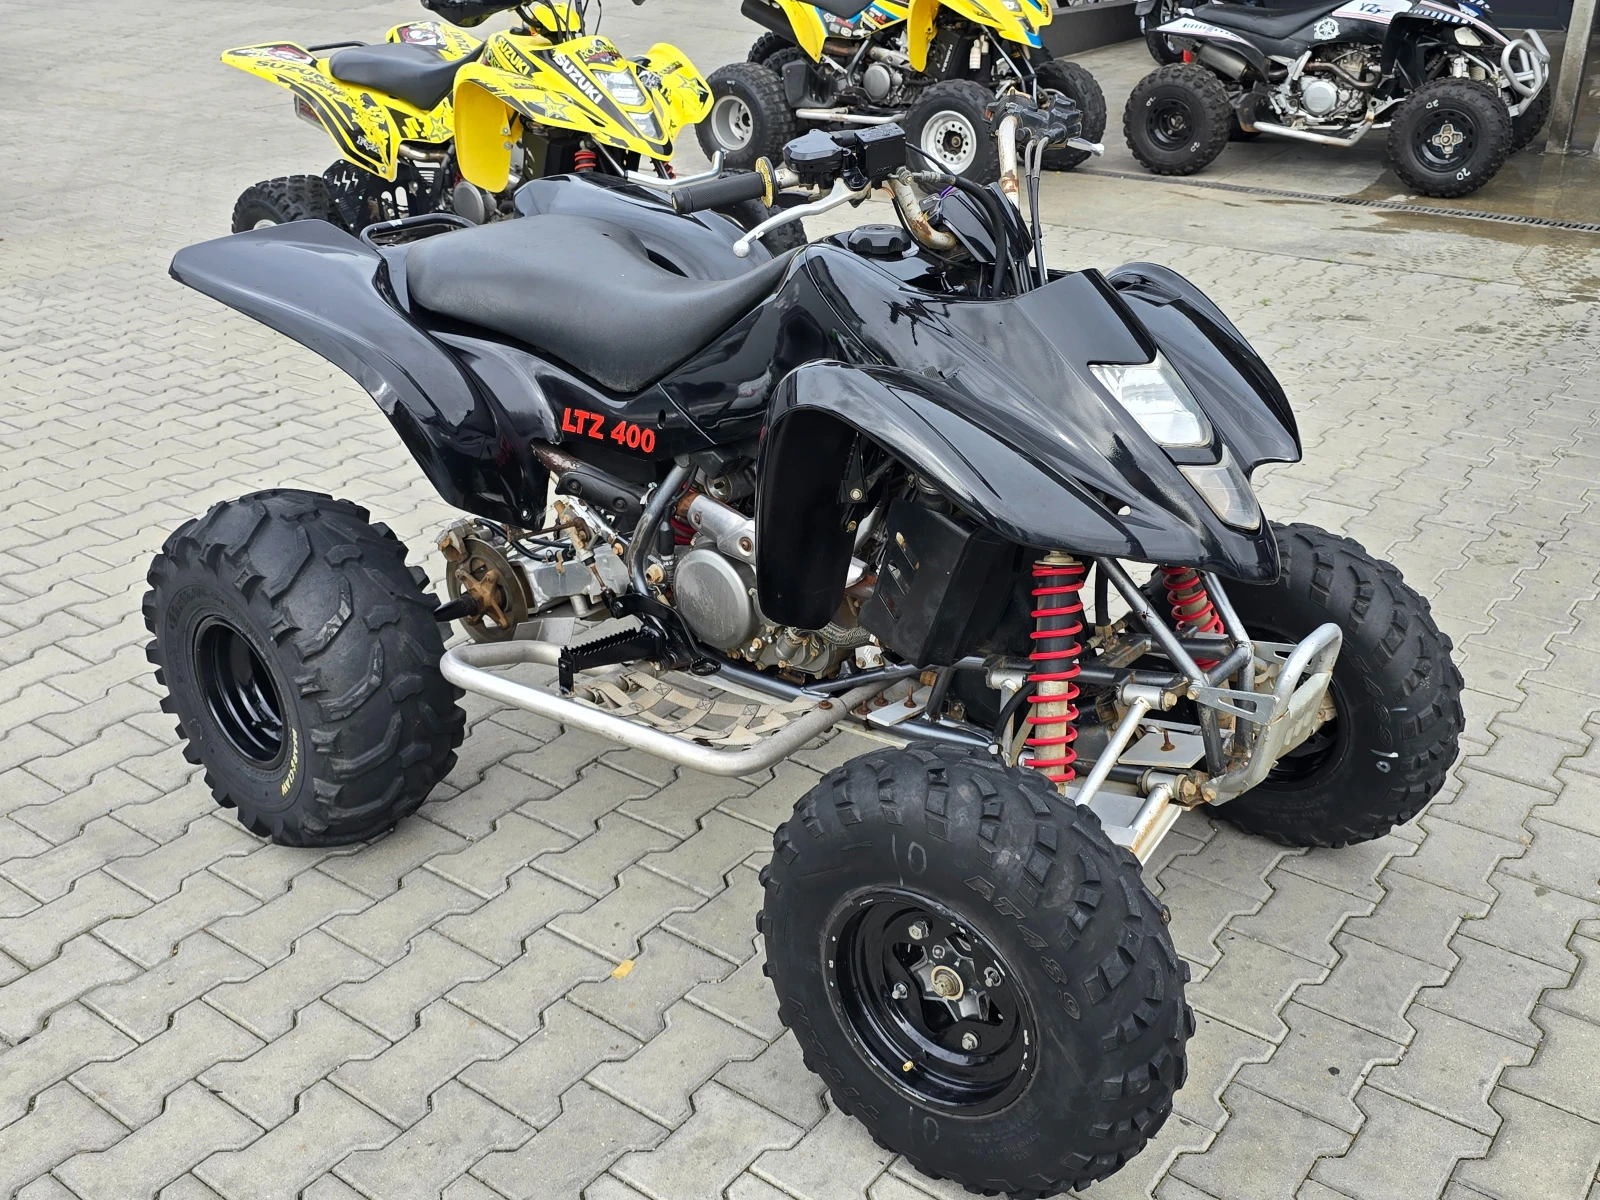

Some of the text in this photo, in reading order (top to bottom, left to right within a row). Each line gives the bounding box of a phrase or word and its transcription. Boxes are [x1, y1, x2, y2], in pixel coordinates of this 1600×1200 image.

[494, 36, 531, 76] SUZUKI
[553, 52, 604, 105] SUZUKI
[562, 407, 655, 453] LTZ 400
[963, 875, 1082, 1021] AT489
